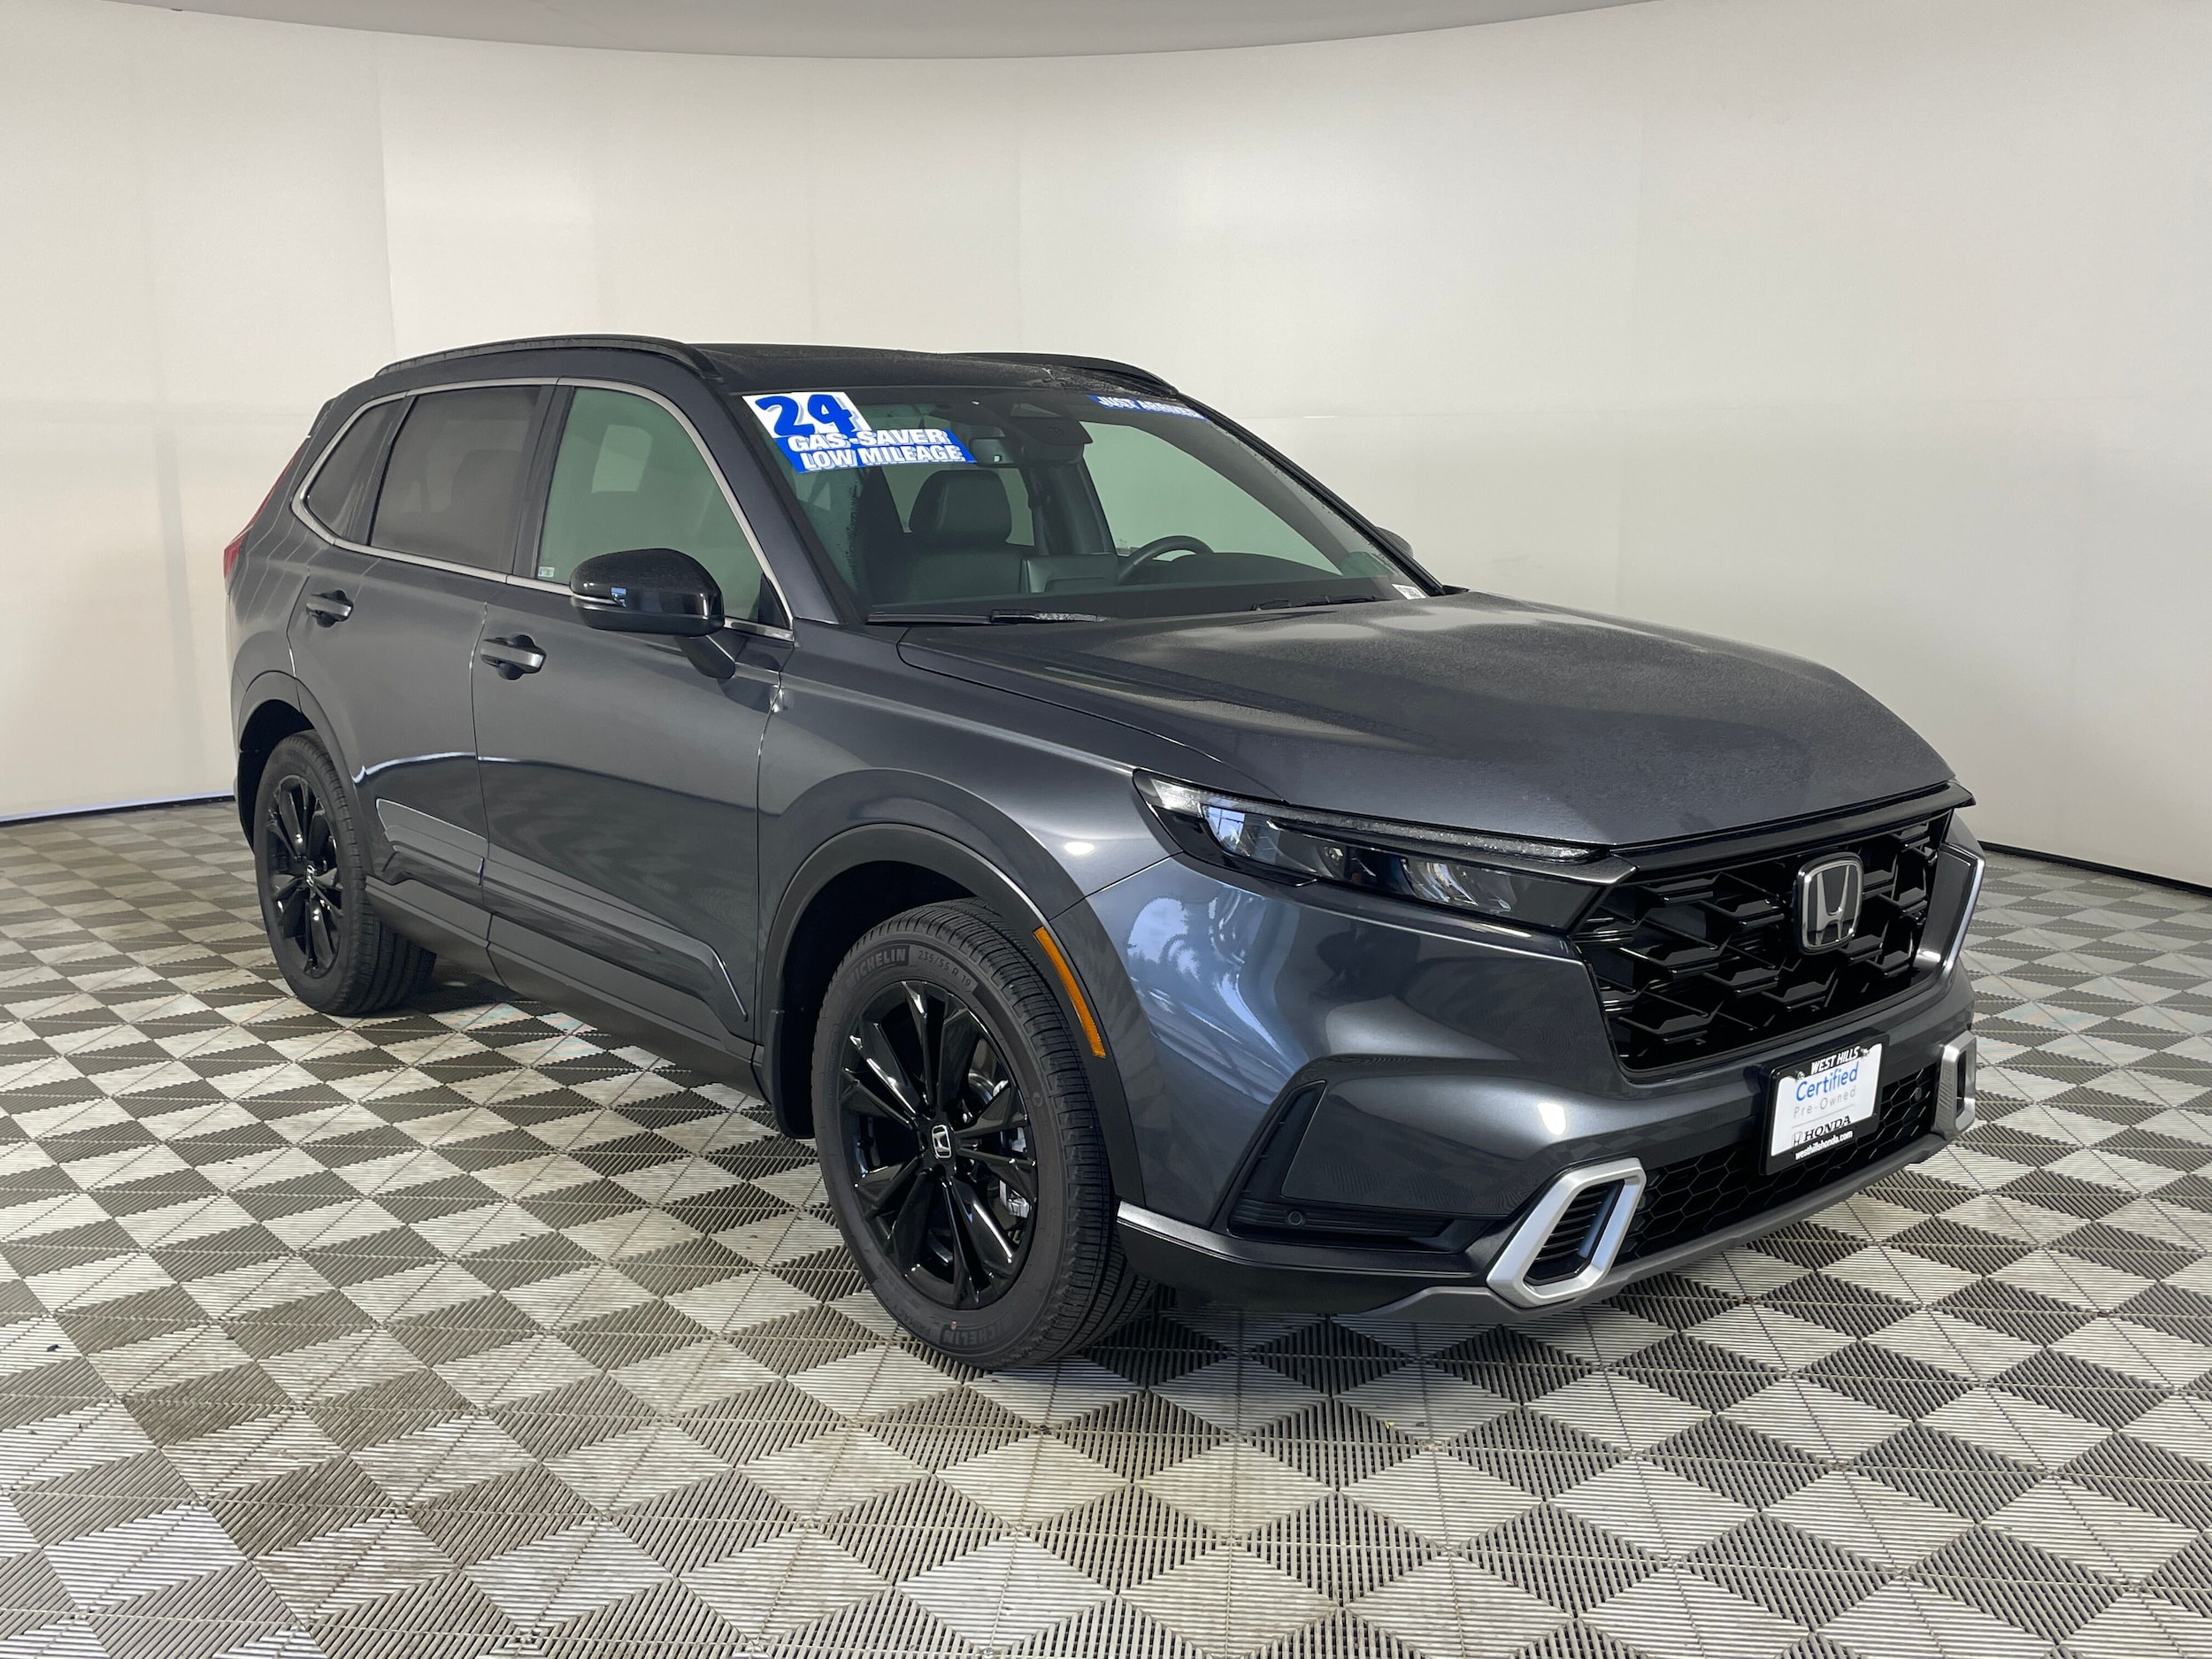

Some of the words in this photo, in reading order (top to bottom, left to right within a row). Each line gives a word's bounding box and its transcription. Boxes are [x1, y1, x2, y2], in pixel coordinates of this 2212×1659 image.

[755, 394, 855, 436] 24
[1096, 396, 1141, 410] JUST
[1136, 400, 1205, 420] ARRIVED
[787, 428, 952, 452] GAS-SAVER
[800, 449, 857, 471] LOW
[856, 444, 966, 465] MILEAGE
[845, 948, 907, 988] MICHELIN
[918, 950, 949, 971] 235/55
[961, 974, 972, 987] 19
[1810, 1055, 1837, 1075] WEST
[1836, 1046, 1861, 1064] HILLS
[1796, 1061, 1859, 1102] Certified
[1793, 1086, 1856, 1118] Pre-Owned
[1803, 1115, 1852, 1141] HONDA
[1794, 1131, 1854, 1161] westhillshonda.com
